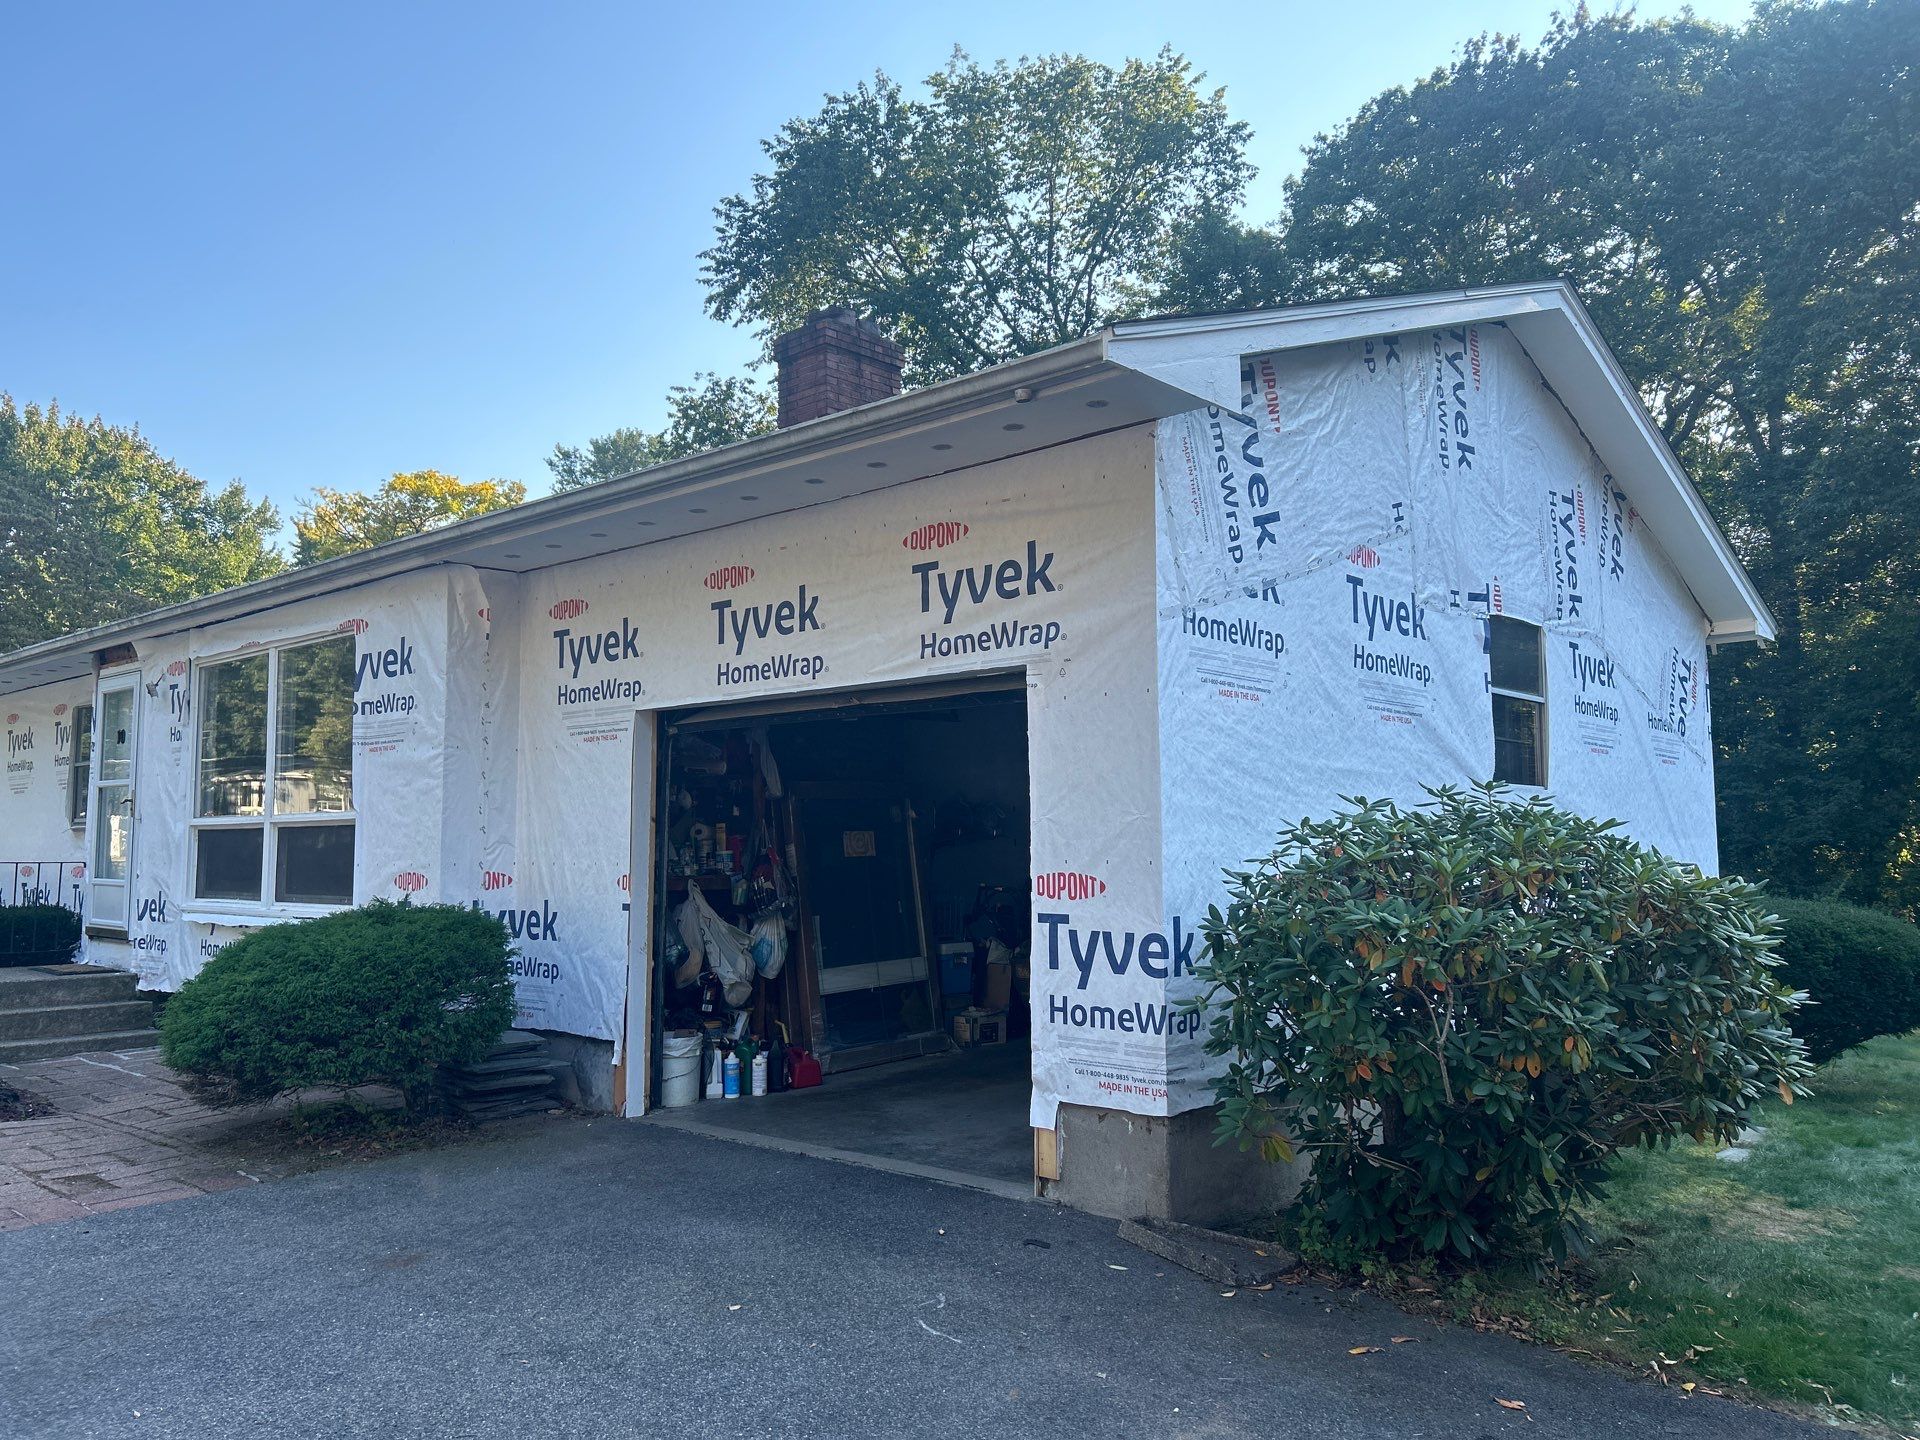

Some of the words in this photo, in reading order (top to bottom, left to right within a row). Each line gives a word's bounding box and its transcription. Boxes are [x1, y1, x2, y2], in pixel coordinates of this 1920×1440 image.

[1445, 326, 1475, 470] Tyvek
[1207, 405, 1243, 563] omeWrap
[910, 522, 961, 550] DUPONT
[1599, 474, 1612, 567] omeWrap
[1611, 486, 1627, 582] yvek
[1549, 490, 1564, 620] HomeWrap
[1559, 489, 1582, 617] Tyvek
[710, 565, 749, 591] DUPONT
[912, 540, 1056, 624] Tyvek
[553, 599, 585, 621] DUPONT
[1346, 574, 1426, 641] Tyvek
[1494, 584, 1502, 614] DUP
[710, 584, 820, 656] Tyvek
[920, 620, 1060, 659] HomeWrap
[1182, 607, 1284, 659] HomeWrap
[352, 636, 412, 692] yvek
[553, 617, 640, 679] Tyvek
[1354, 644, 1430, 687] HomeWrap
[1569, 641, 1616, 692] Tyvek
[717, 654, 824, 685] HomeWrap
[1668, 647, 1679, 724] HomeW
[352, 693, 414, 715] omeWrap
[558, 678, 642, 705] HomeWrap
[1219, 689, 1233, 698] MADE
[1240, 692, 1249, 701] THE
[1250, 694, 1260, 702] USA
[1575, 695, 1619, 726] HomeWrap
[1678, 658, 1691, 737] Tyve
[8, 726, 34, 758] Tyvek
[55, 721, 71, 751] Tyv
[55, 755, 69, 767] Home
[397, 872, 425, 891] DUPONT
[484, 871, 506, 890] ONT
[1037, 872, 1097, 900] DUPONT
[137, 891, 166, 923] vek
[498, 900, 557, 941] vek
[511, 956, 559, 984] eWrap
[1037, 913, 1196, 990] Tyvek
[1049, 994, 1201, 1039] HomeWrap
[1099, 1081, 1121, 1091] MADE
[1124, 1085, 1132, 1093] IN
[1134, 1086, 1149, 1095] THE
[1152, 1088, 1168, 1098] USA
